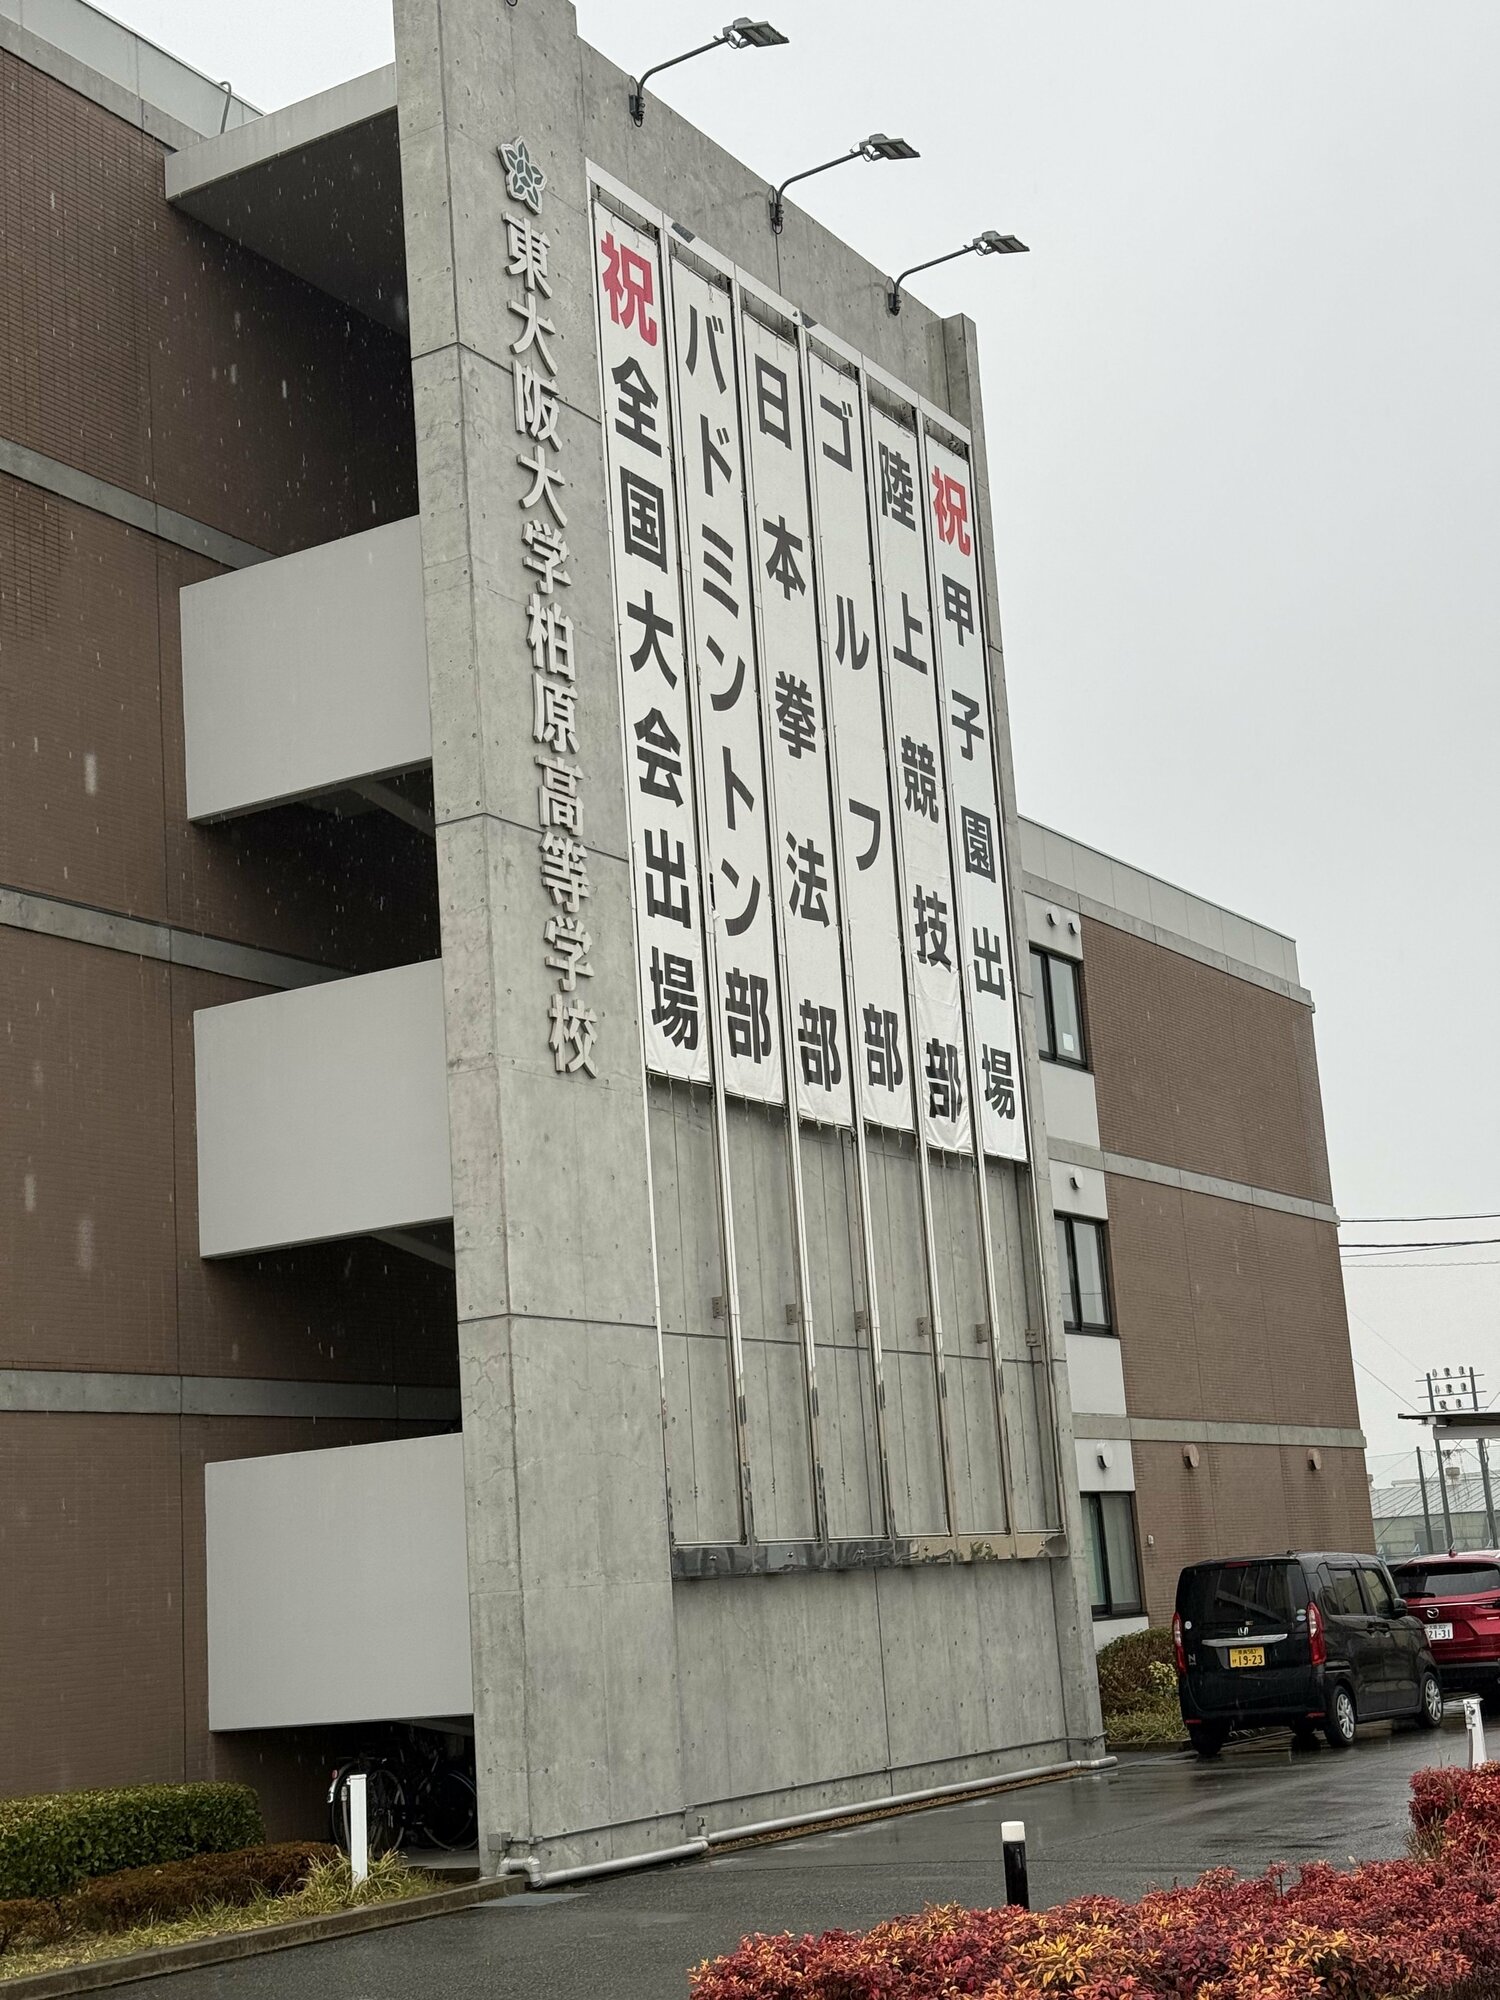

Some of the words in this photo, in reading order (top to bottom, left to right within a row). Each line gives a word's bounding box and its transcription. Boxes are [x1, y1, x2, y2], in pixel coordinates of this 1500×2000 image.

[502, 212, 598, 1079] 東大阪大学柏原高等学校
[684, 304, 772, 1065] バドミントン部
[754, 352, 842, 1092] 日本拳法部
[818, 393, 902, 1093] ゴルフ部
[878, 440, 962, 1123] 陸上競技部
[1238, 1654, 1263, 1666] 19-23
[1428, 1629, 1451, 1639] 21-31
